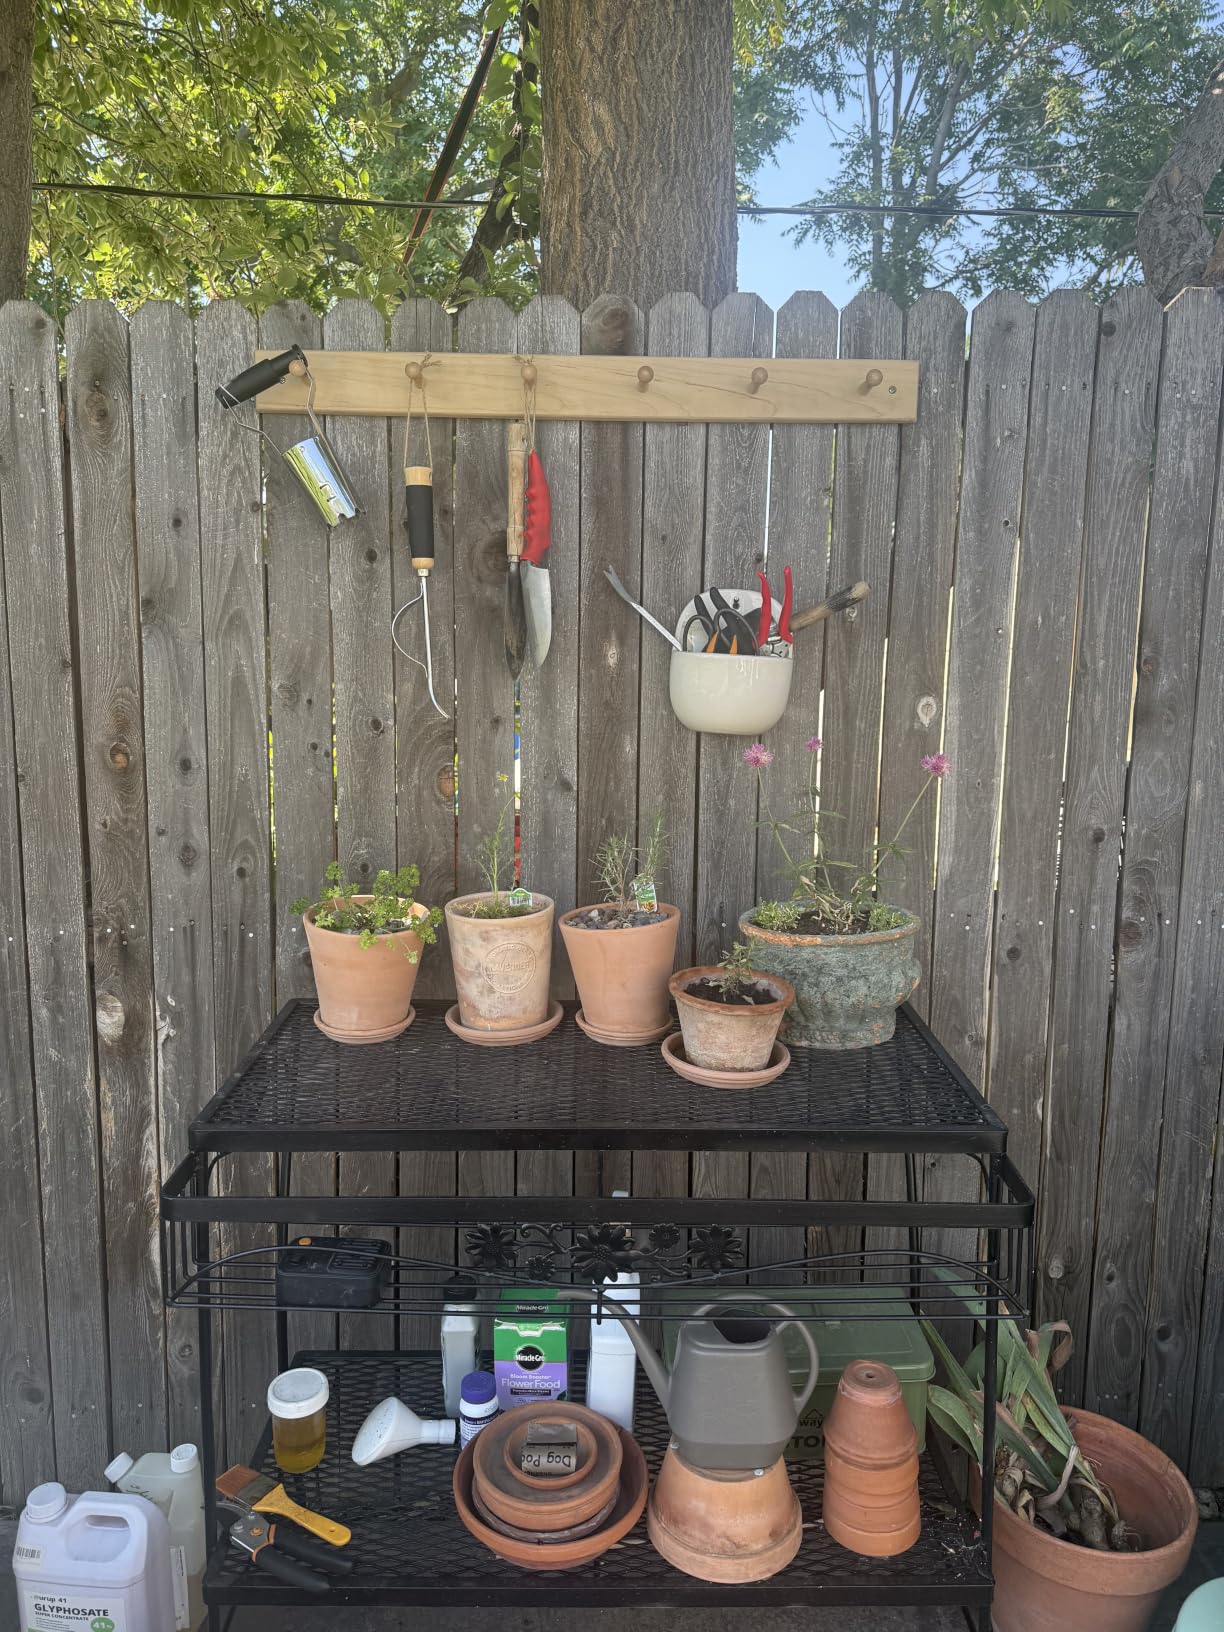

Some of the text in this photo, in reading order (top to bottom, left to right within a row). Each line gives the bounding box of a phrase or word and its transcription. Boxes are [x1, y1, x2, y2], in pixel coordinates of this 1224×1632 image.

[501, 1377, 561, 1388] Flower Food
[546, 1451, 572, 1468] Dog
[34, 1602, 109, 1617] GLYPHOSATE
